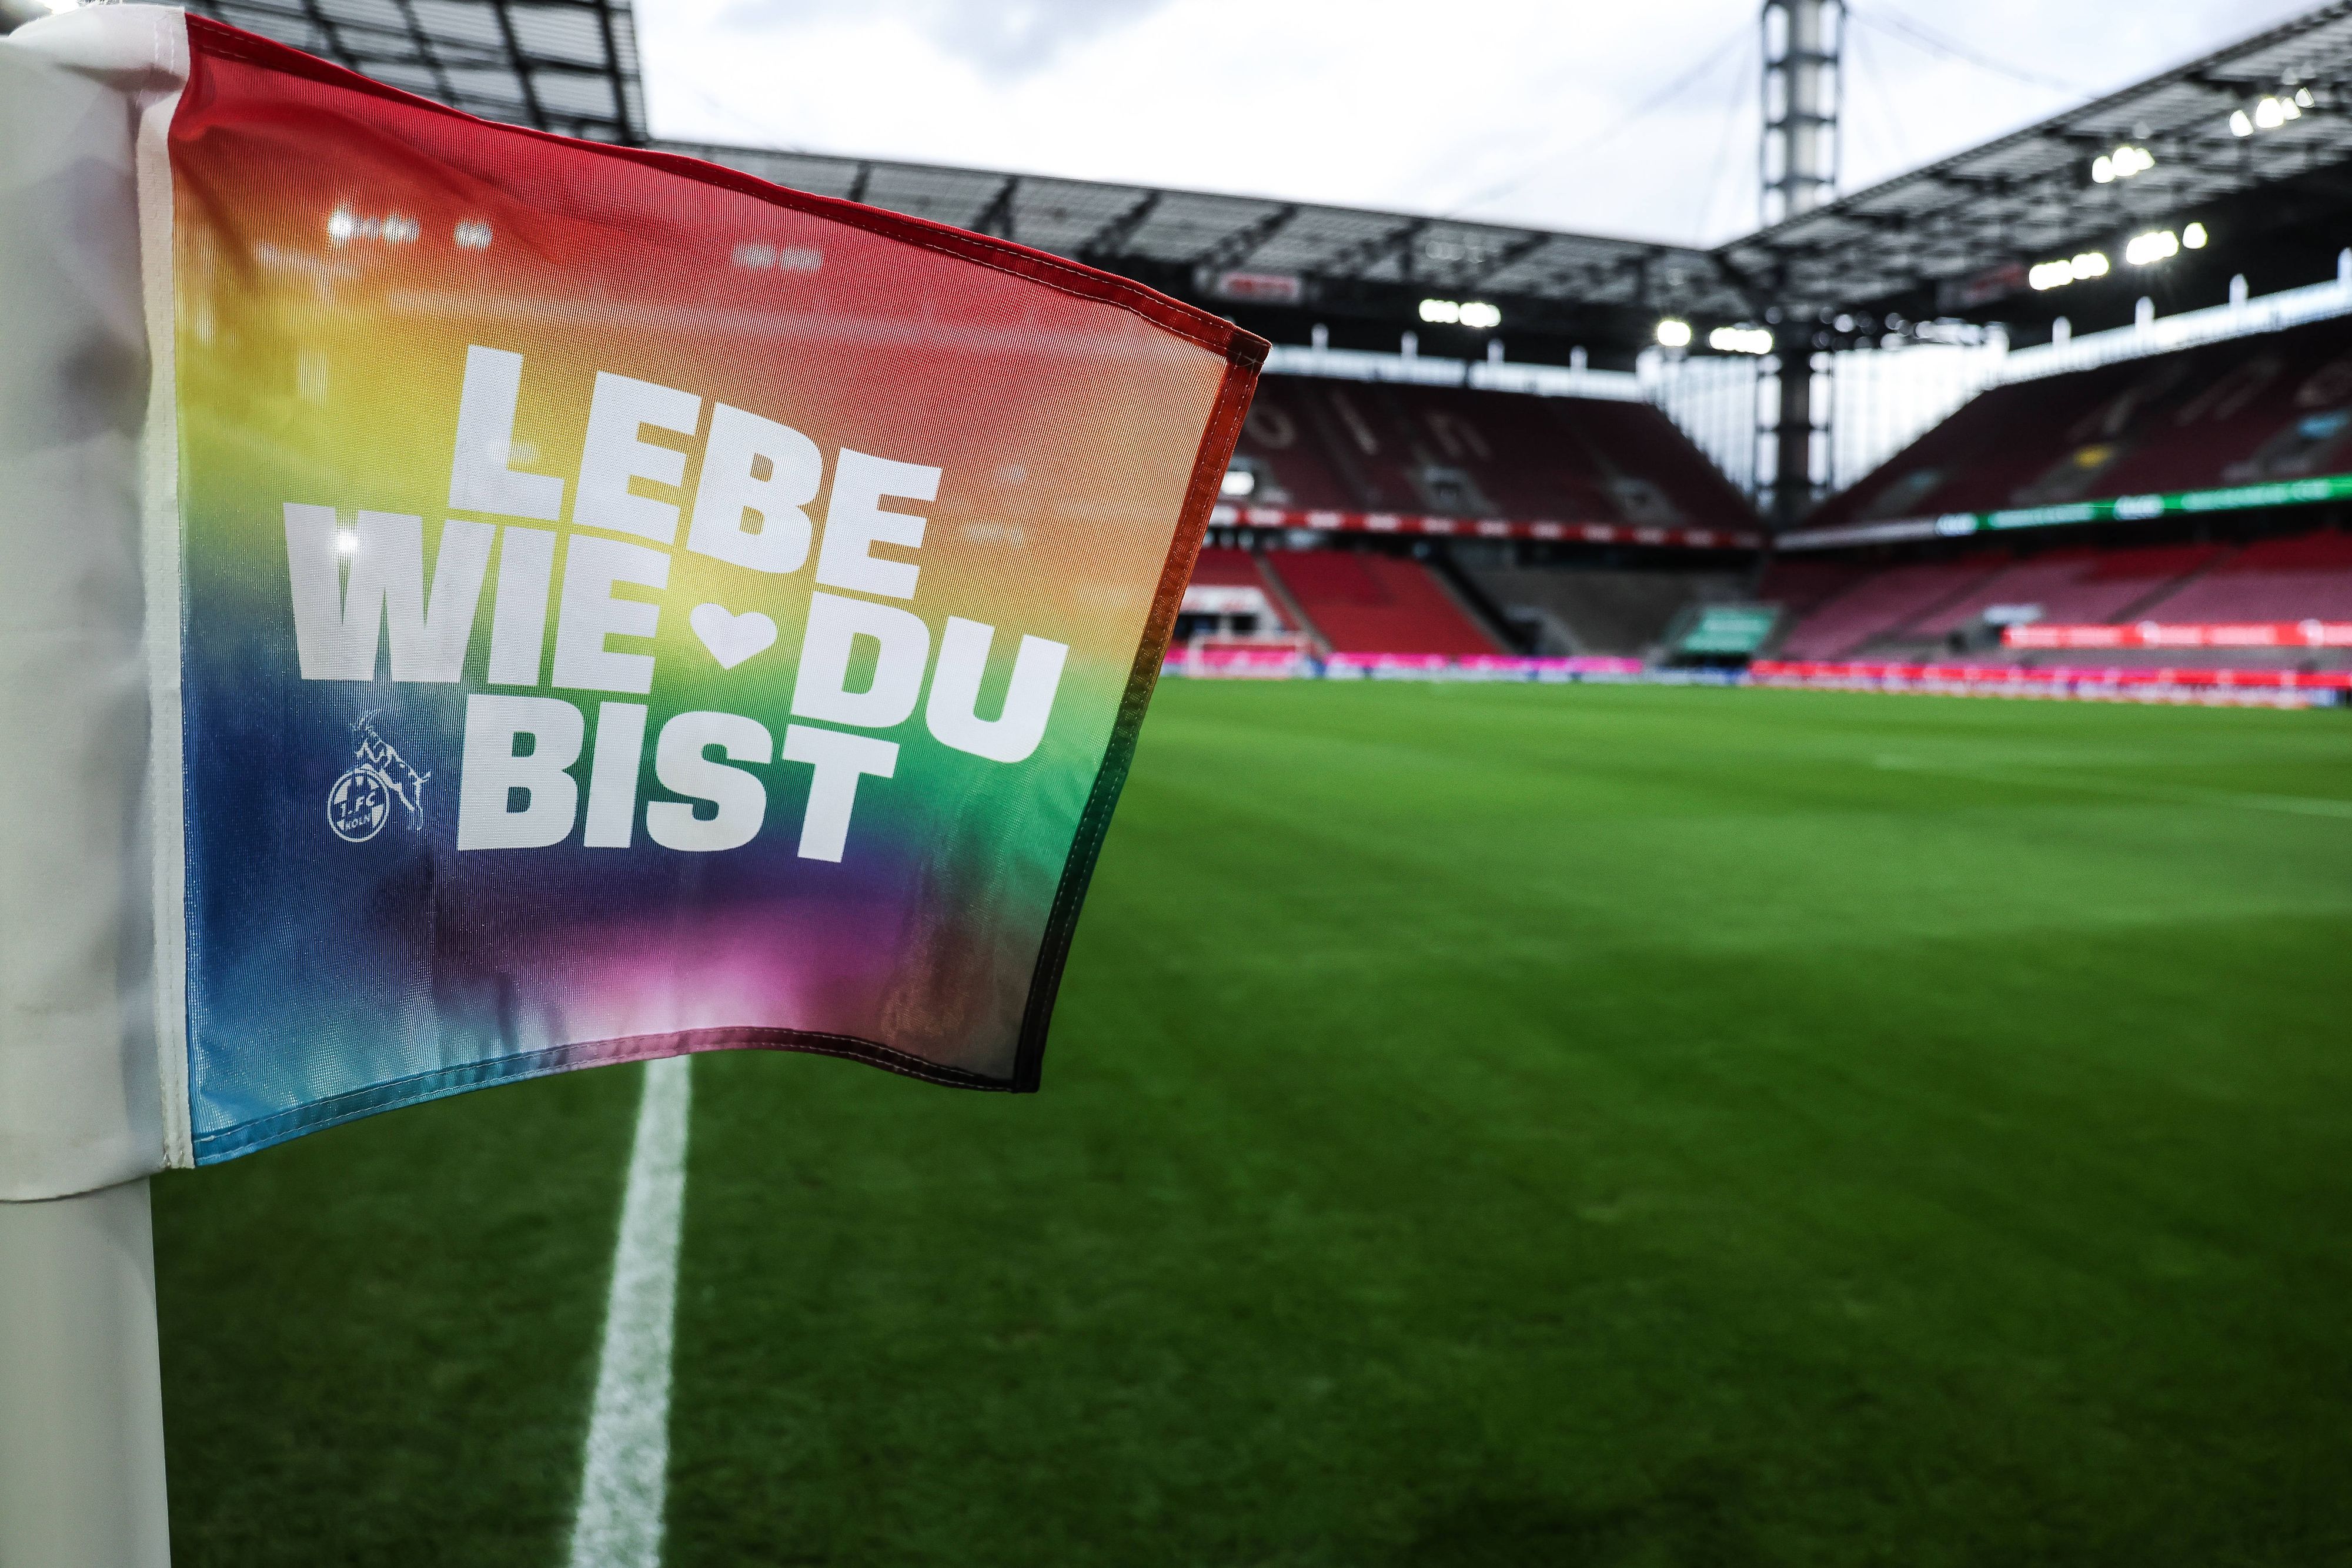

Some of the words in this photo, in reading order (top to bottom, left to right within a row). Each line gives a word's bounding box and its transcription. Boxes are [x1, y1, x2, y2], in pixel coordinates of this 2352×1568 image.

[448, 345, 943, 600] LEBE
[283, 502, 671, 694] WIE
[790, 590, 1070, 764] DU
[457, 694, 900, 863] BIST
